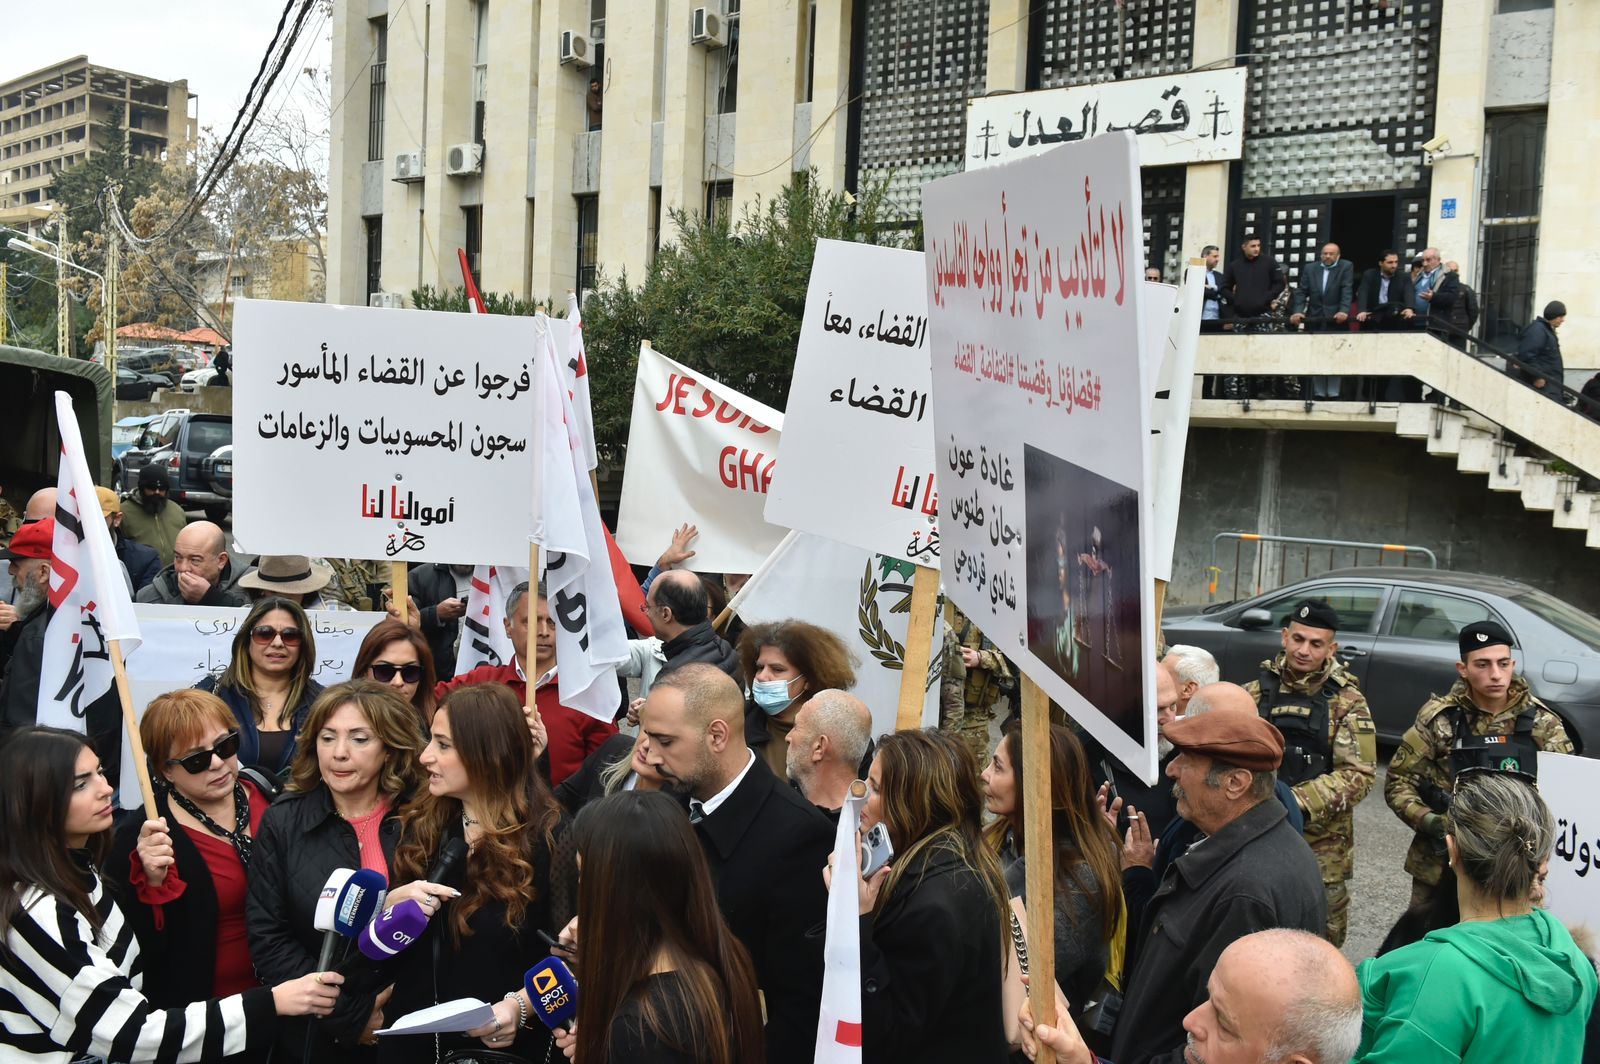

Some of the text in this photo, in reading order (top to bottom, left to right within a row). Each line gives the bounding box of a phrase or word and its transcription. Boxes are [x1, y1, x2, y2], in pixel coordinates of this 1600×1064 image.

[1008, 99, 1098, 148] العدل
[973, 219, 1002, 312] وواجه
[1002, 190, 1028, 317] تجرأ
[1035, 230, 1051, 320] من
[1057, 176, 1106, 331] لتأديب
[1112, 201, 1124, 306] لا
[277, 342, 348, 388] المأسور
[358, 354, 424, 386] القضاء
[433, 363, 466, 396] عن
[475, 357, 535, 400] فرجوا
[830, 377, 927, 422] القضاء
[258, 410, 526, 460] سجون المحسوبيات والزعامات
[949, 433, 1014, 491] غادة عون
[361, 483, 455, 527] أموالنا لنا
[892, 465, 920, 510] لنا
[951, 488, 1016, 559] جان طنوس
[990, 569, 1016, 614] شادي
[347, 888, 366, 927] INTERNATIONAL
[392, 931, 415, 945] OTV
[540, 985, 565, 1006] SPOT
[545, 993, 569, 1014] SHOT
